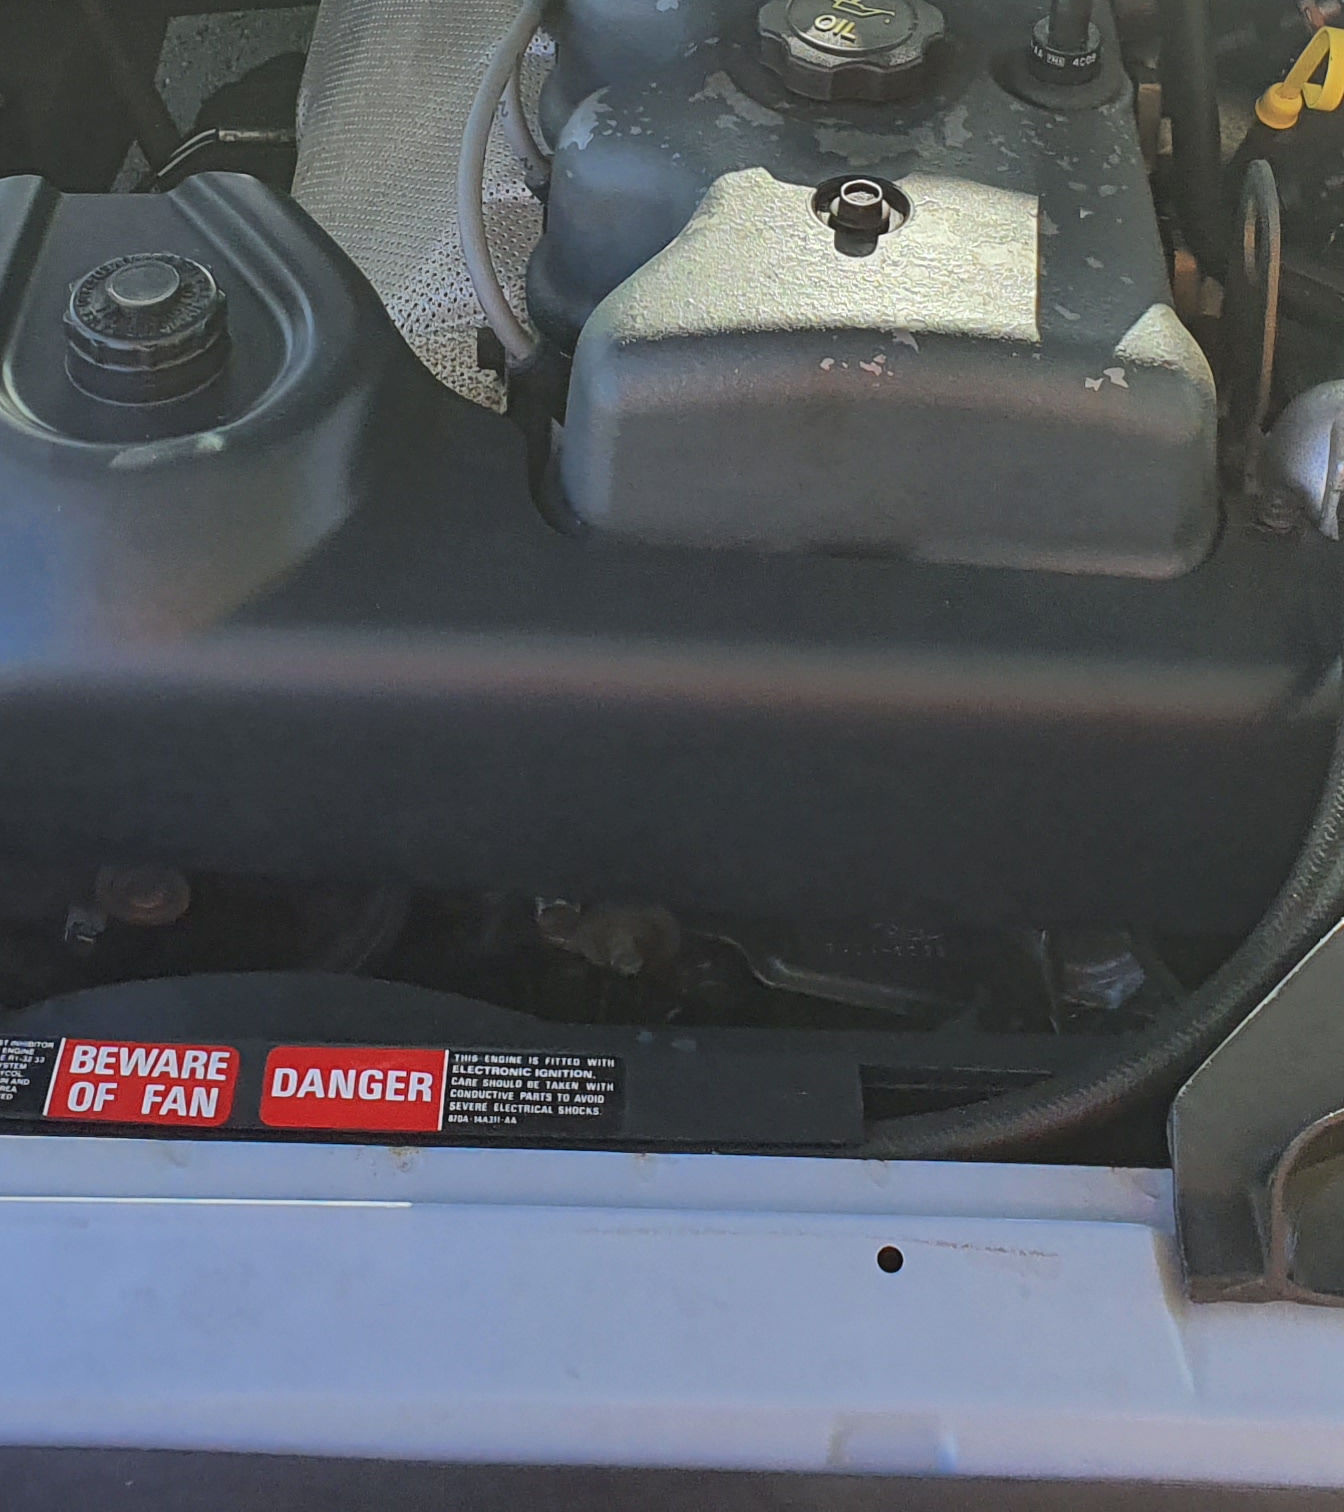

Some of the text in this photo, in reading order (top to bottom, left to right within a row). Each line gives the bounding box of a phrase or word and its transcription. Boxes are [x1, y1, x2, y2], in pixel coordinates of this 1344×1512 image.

[814, 14, 856, 40] OIL
[2, 1047, 35, 1055] ENGINE
[69, 1044, 230, 1081] BEWARE
[455, 1054, 615, 1068] THIS ENGINE IS FITTED WITH
[452, 1065, 596, 1079] ELECTRONIC IGNITION.
[10, 1078, 31, 1086] AND
[270, 1067, 433, 1102] DANGER
[451, 1077, 614, 1092] CARE SHOULD BE TAKEN WITH
[66, 1080, 219, 1118] OF FAN
[450, 1089, 604, 1104] CONDUCTIVE PARTS TO AVOID
[449, 1101, 487, 1112] SEVERE
[494, 1103, 553, 1114] ELECTRICAL
